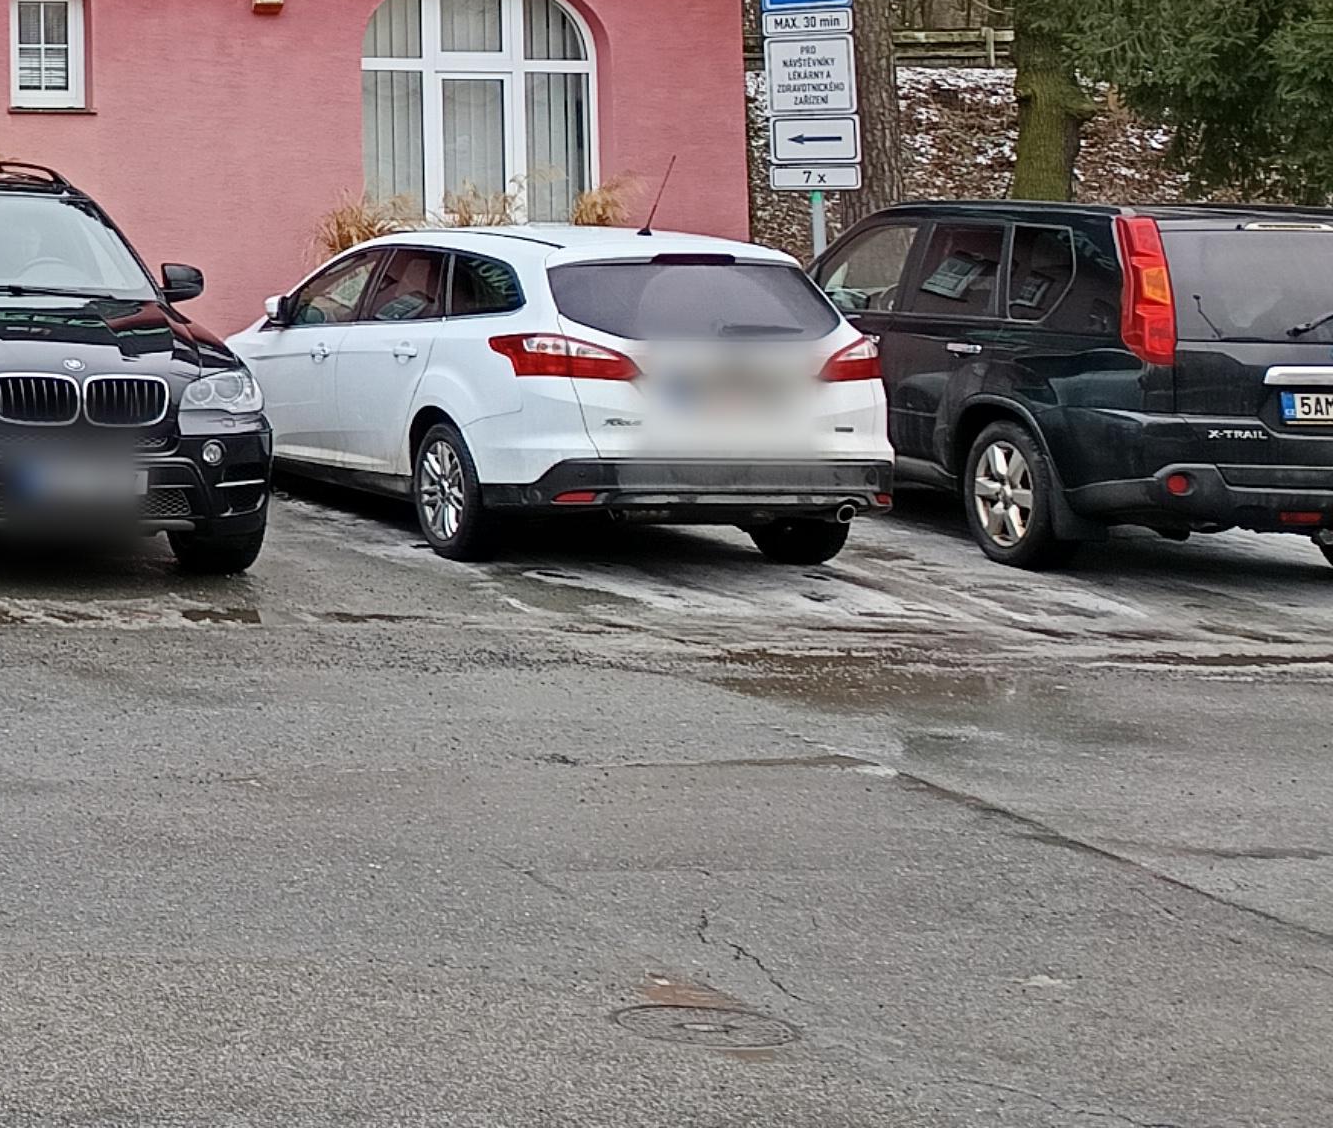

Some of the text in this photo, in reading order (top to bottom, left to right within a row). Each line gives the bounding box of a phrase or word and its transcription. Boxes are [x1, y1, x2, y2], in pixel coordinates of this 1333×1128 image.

[774, 15, 841, 30] MAX. 30 min
[800, 45, 817, 55] PRO
[803, 170, 812, 183] 7
[1207, 429, 1268, 439] X-TRAIL
